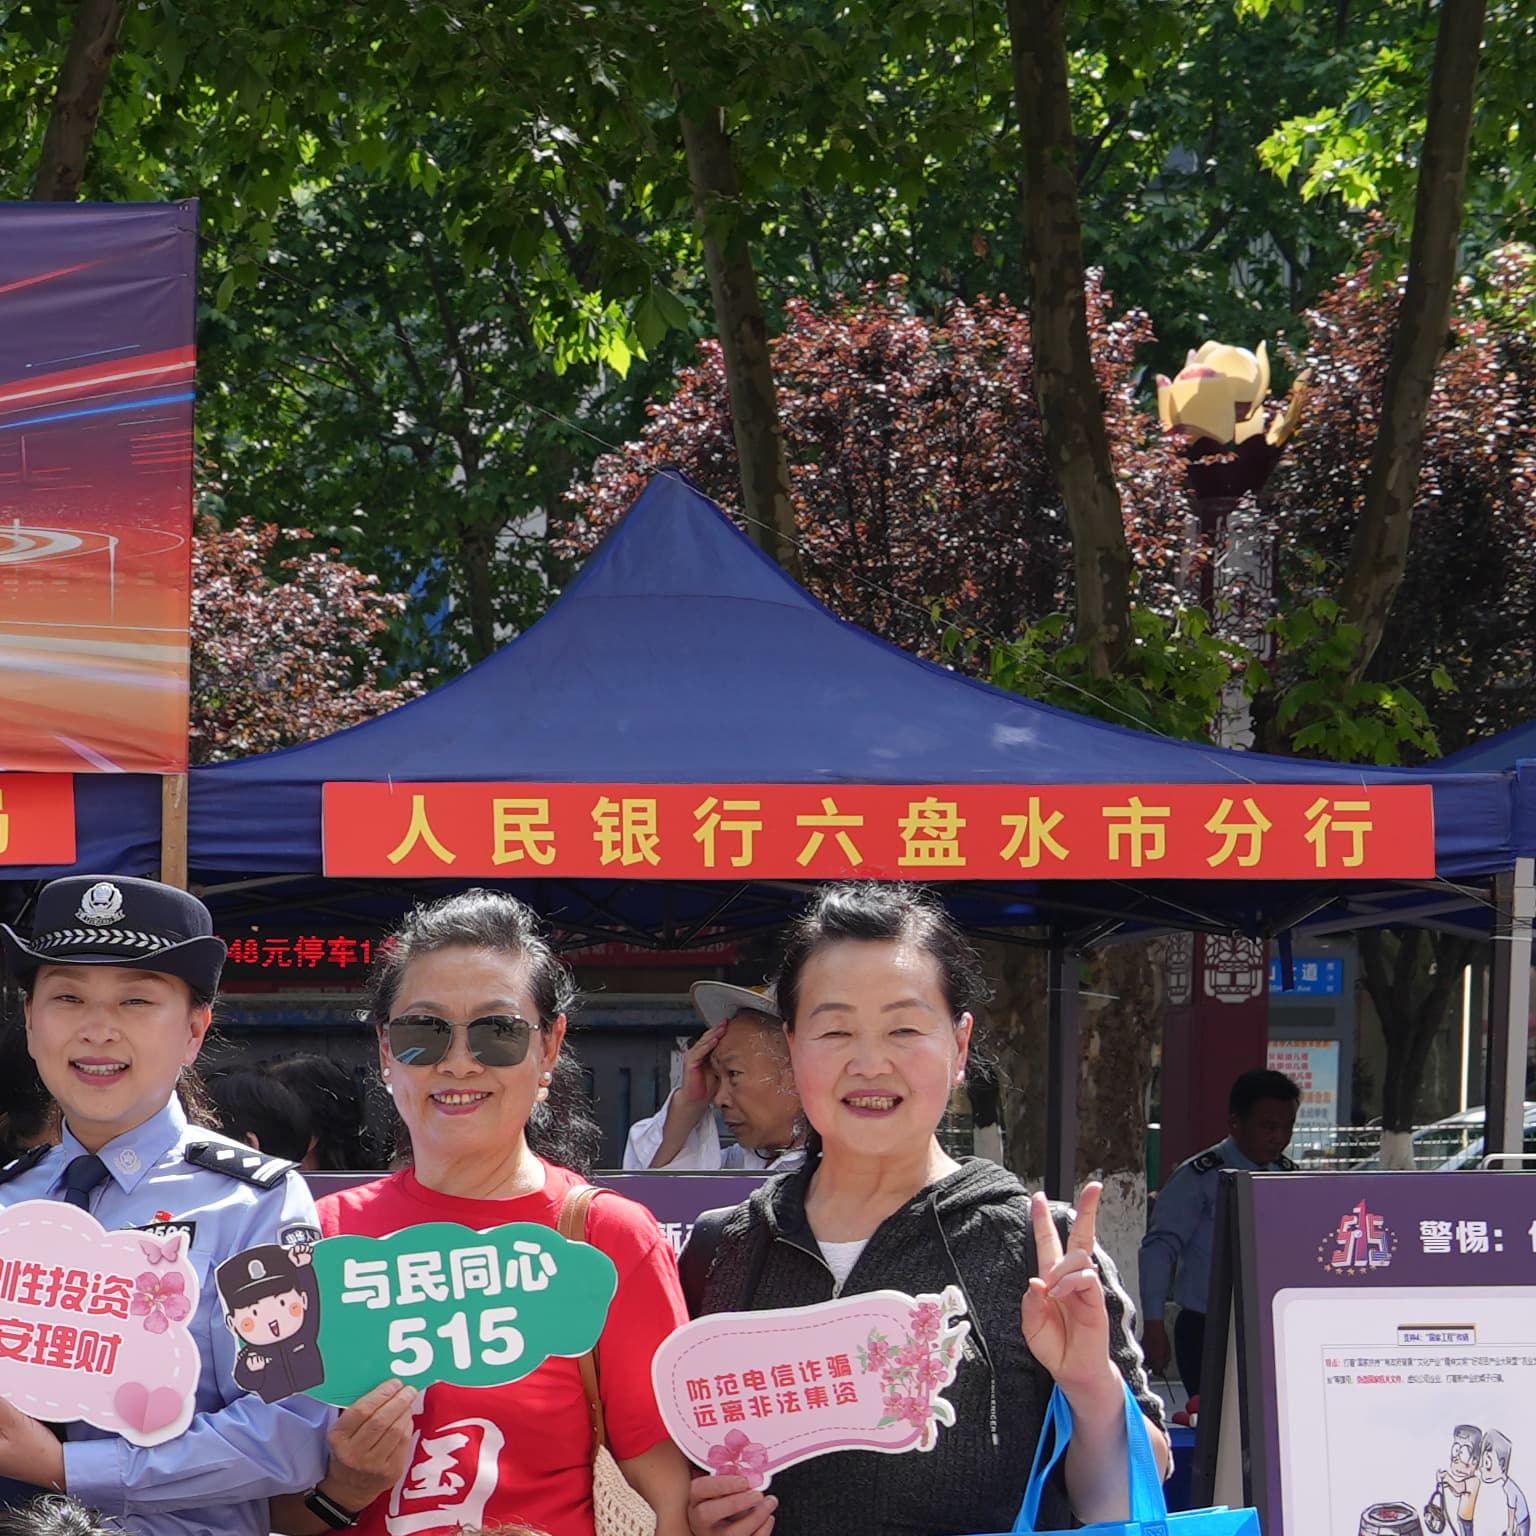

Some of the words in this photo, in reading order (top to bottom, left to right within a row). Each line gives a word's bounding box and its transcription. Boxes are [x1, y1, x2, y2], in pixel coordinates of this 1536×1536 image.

[388, 794, 1374, 871] 人民银行六盘水市分行
[341, 1240, 558, 1309] 与民同心
[388, 1306, 525, 1377] 515
[686, 1353, 853, 1402] 防范电信诈骗
[693, 1380, 859, 1430] 远离非法集资
